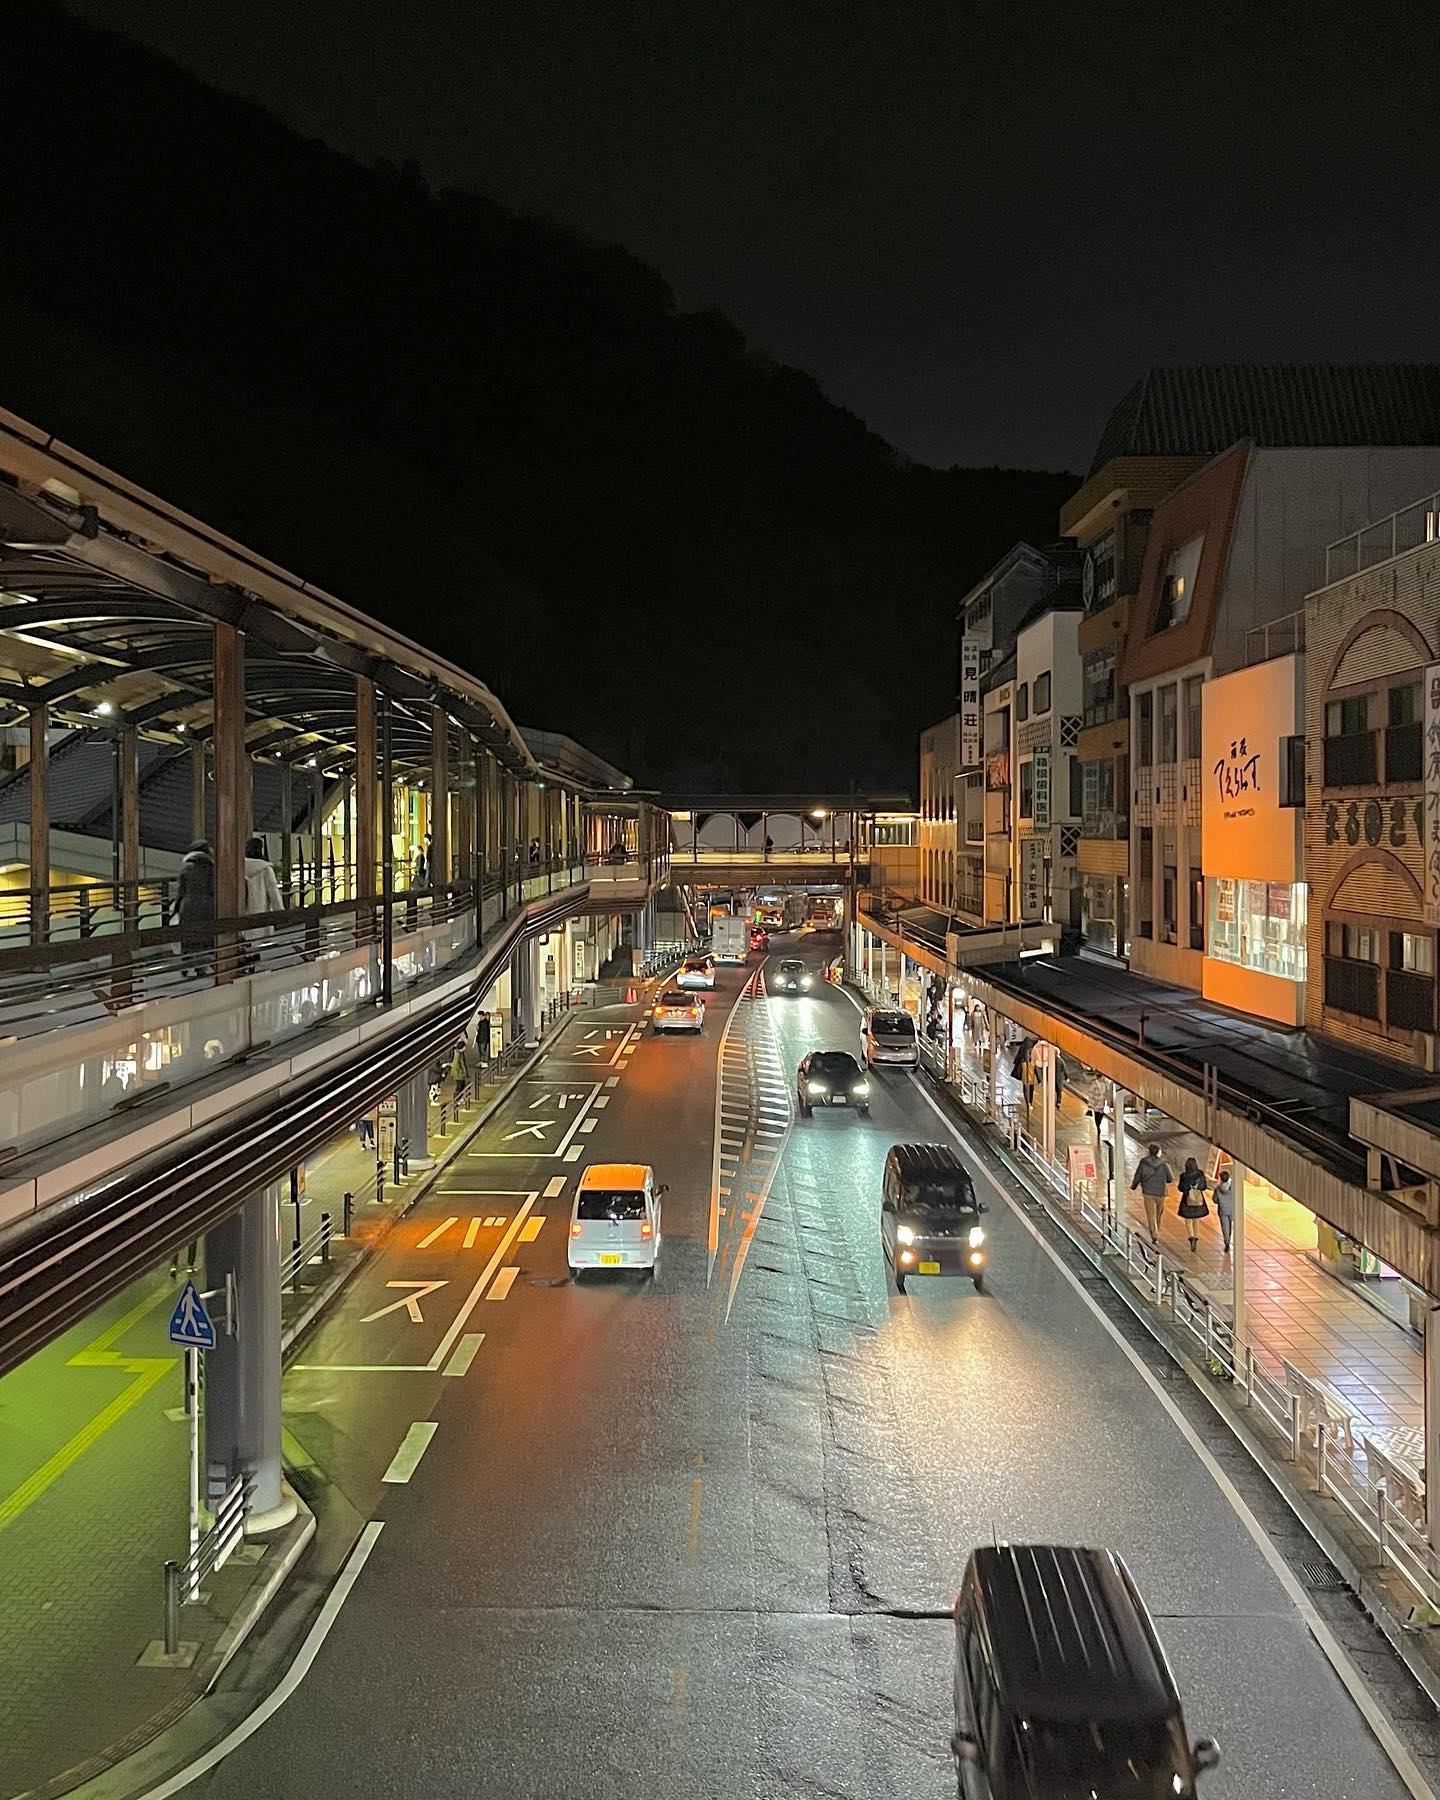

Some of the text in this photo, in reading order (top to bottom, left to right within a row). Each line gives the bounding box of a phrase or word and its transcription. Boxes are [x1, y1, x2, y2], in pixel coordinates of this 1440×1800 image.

[964, 667, 977, 726] 見晴荘
[571, 1030, 624, 1056] バス
[501, 1094, 584, 1141] バス
[360, 1216, 507, 1323] バス
